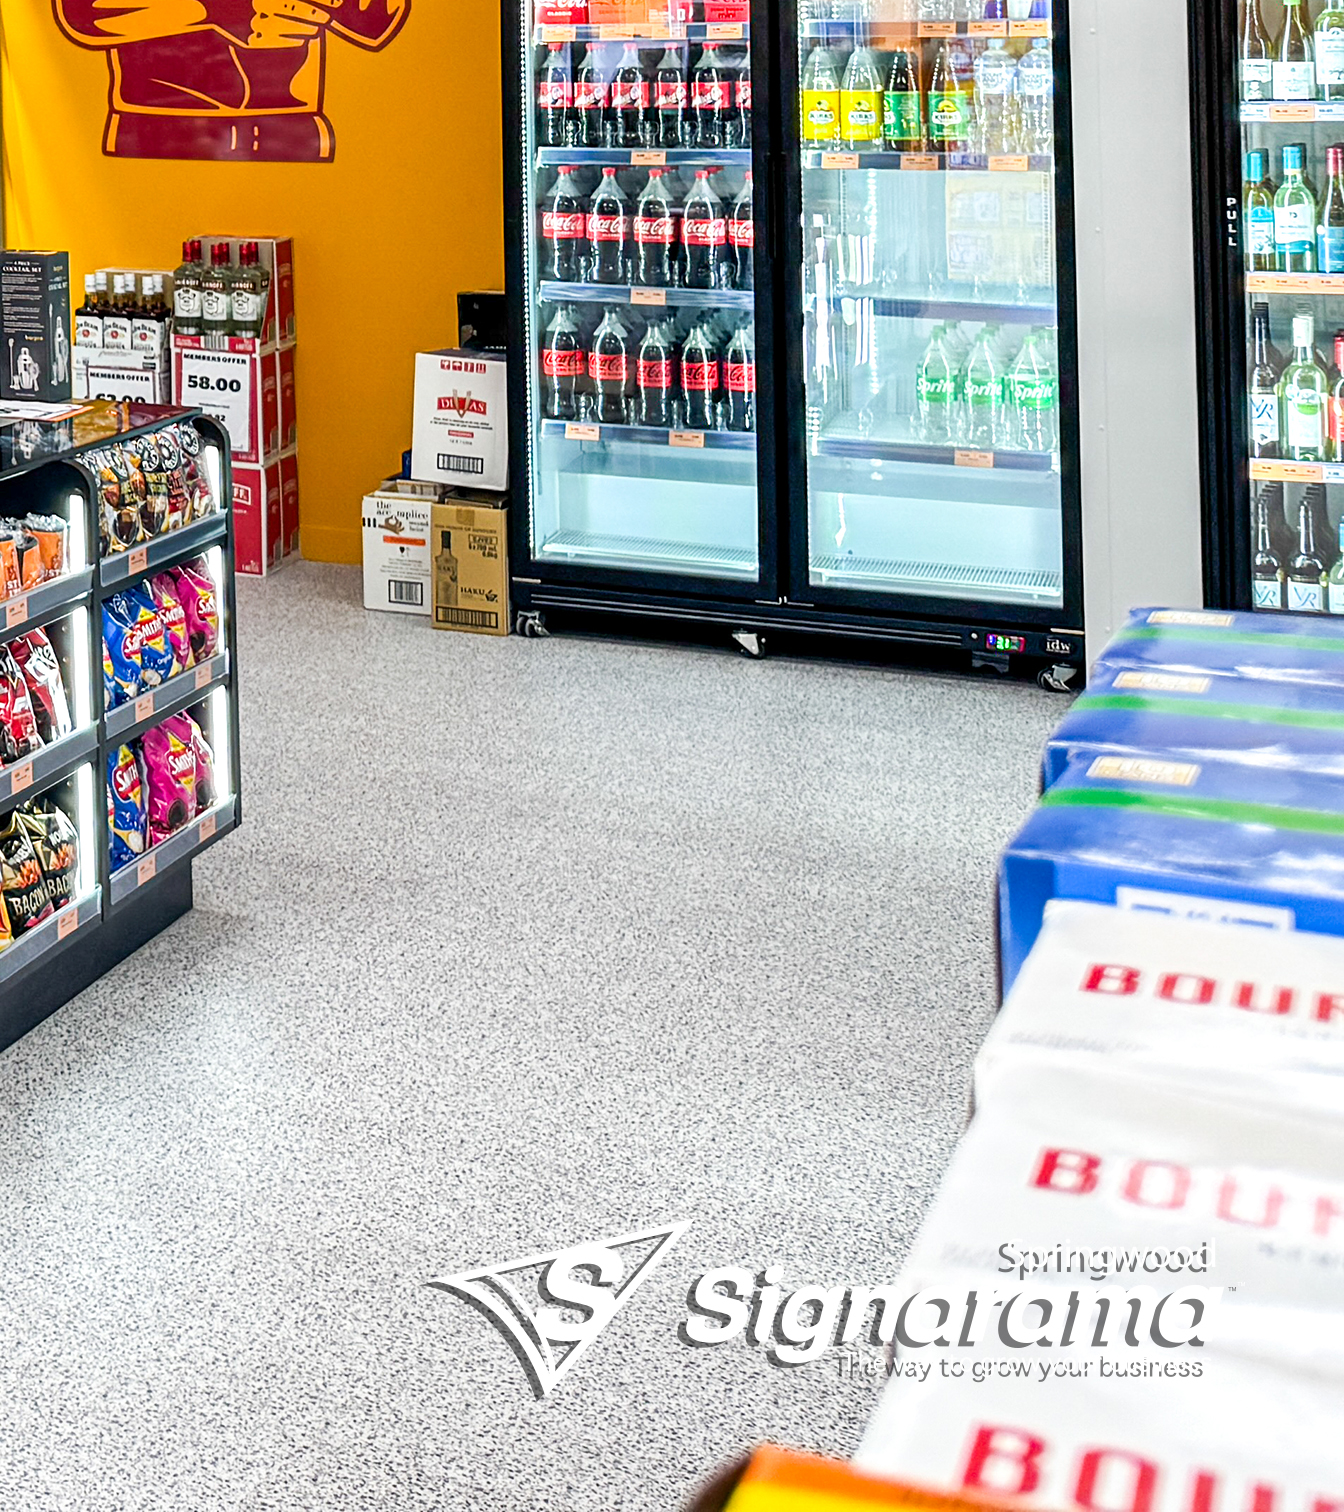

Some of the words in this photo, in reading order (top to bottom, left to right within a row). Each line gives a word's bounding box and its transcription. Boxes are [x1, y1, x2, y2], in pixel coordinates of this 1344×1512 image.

[1226, 197, 1237, 247] PULL
[187, 374, 242, 393] 58.00
[9, 886, 46, 917] BACON
